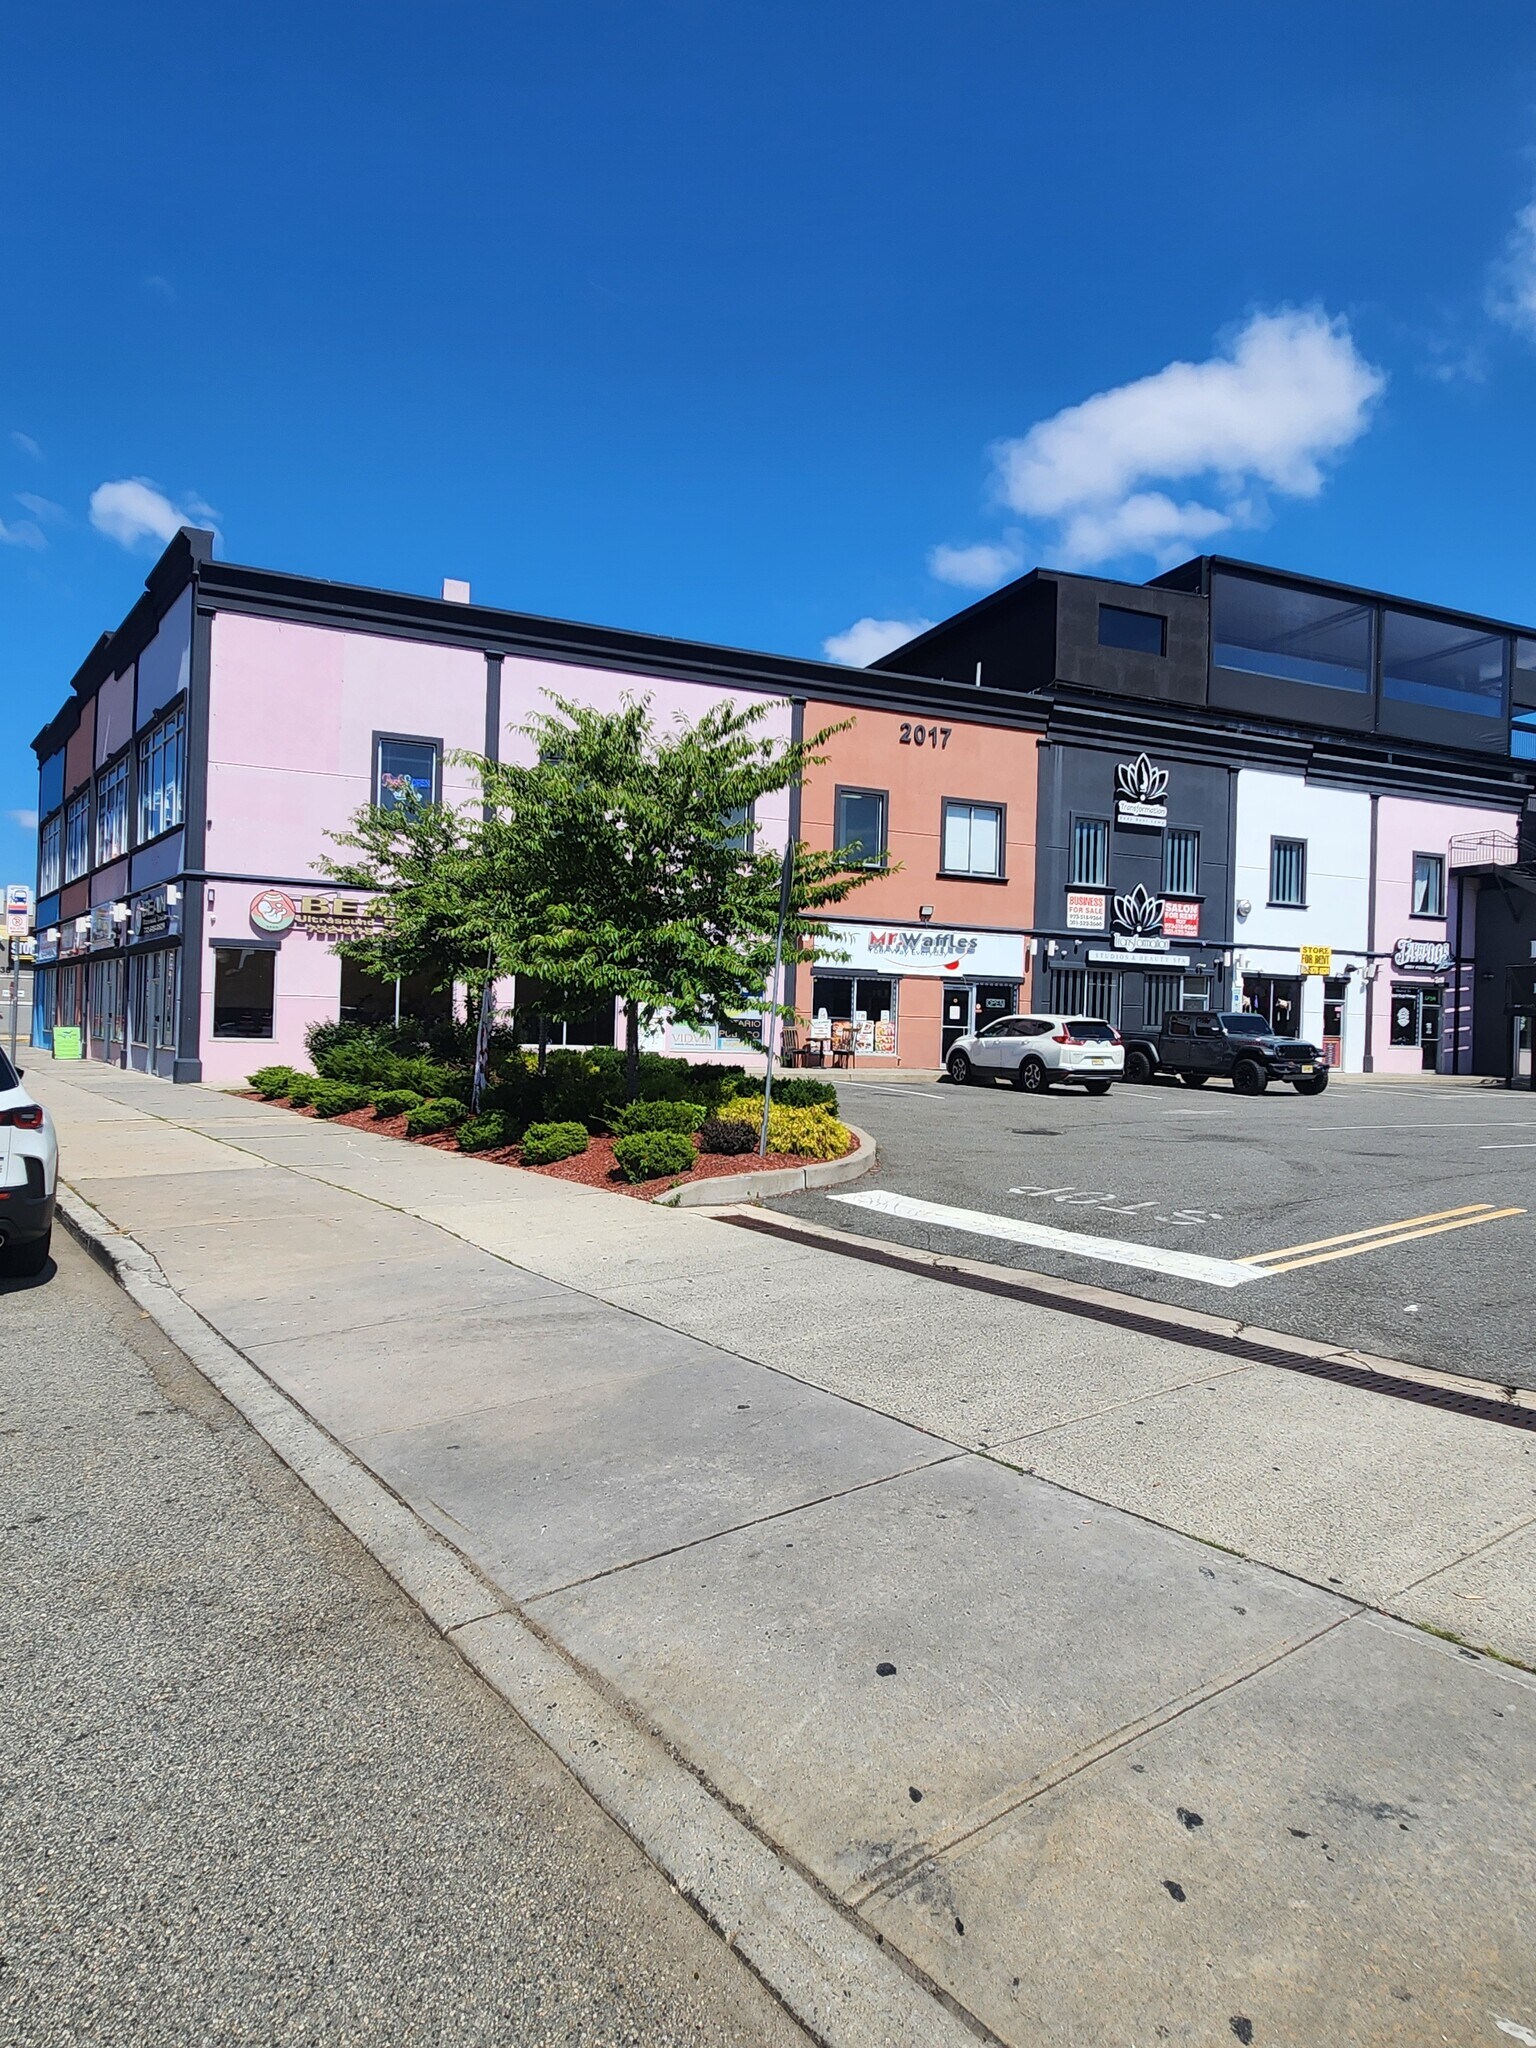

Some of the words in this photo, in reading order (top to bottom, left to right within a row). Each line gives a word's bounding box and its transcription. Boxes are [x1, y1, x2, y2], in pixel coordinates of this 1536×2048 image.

[899, 723, 952, 750] 2017
[1069, 896, 1103, 907] BUSINESS
[1085, 907, 1103, 915] SALE
[1165, 903, 1198, 913] SALON
[1302, 946, 1330, 955] STORE
[1301, 954, 1313, 964] FOR
[1007, 1185, 1224, 1226] STOP
